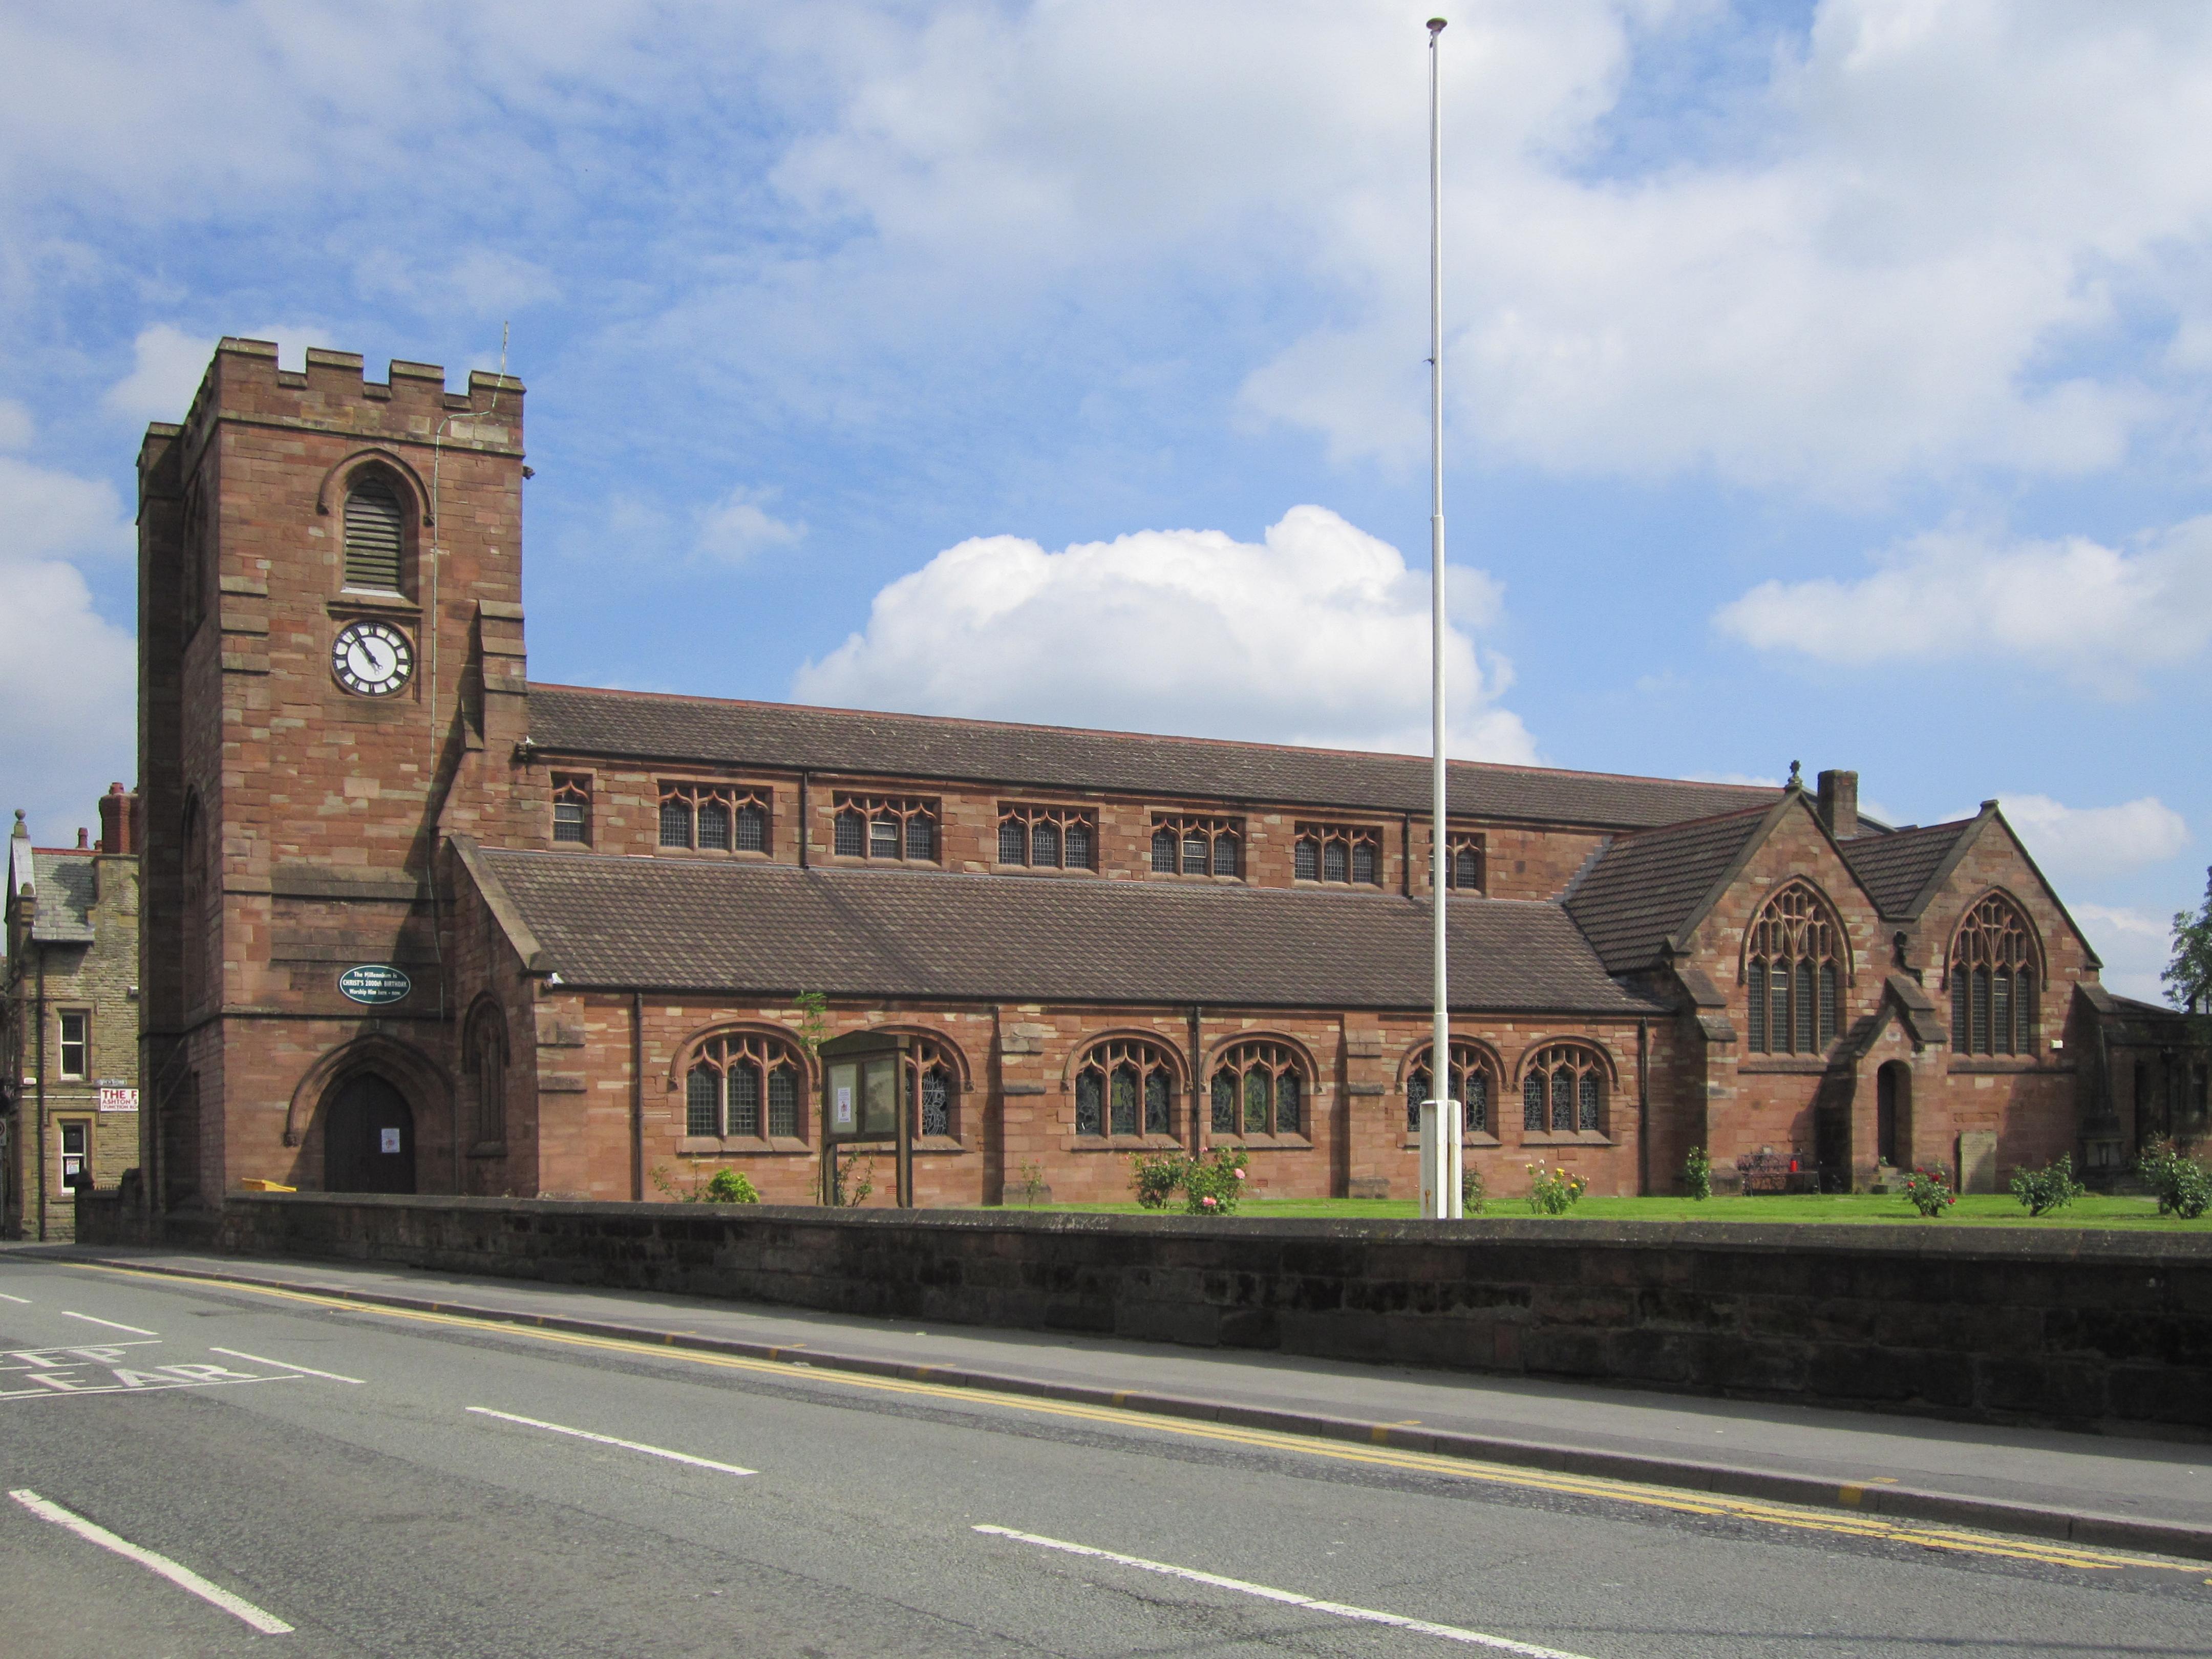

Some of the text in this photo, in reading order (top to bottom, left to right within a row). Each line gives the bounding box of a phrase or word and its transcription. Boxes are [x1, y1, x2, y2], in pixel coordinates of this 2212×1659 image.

[349, 988, 367, 996] Worship
[102, 1090, 126, 1099] THE
[0, 1348, 126, 1371] EP
